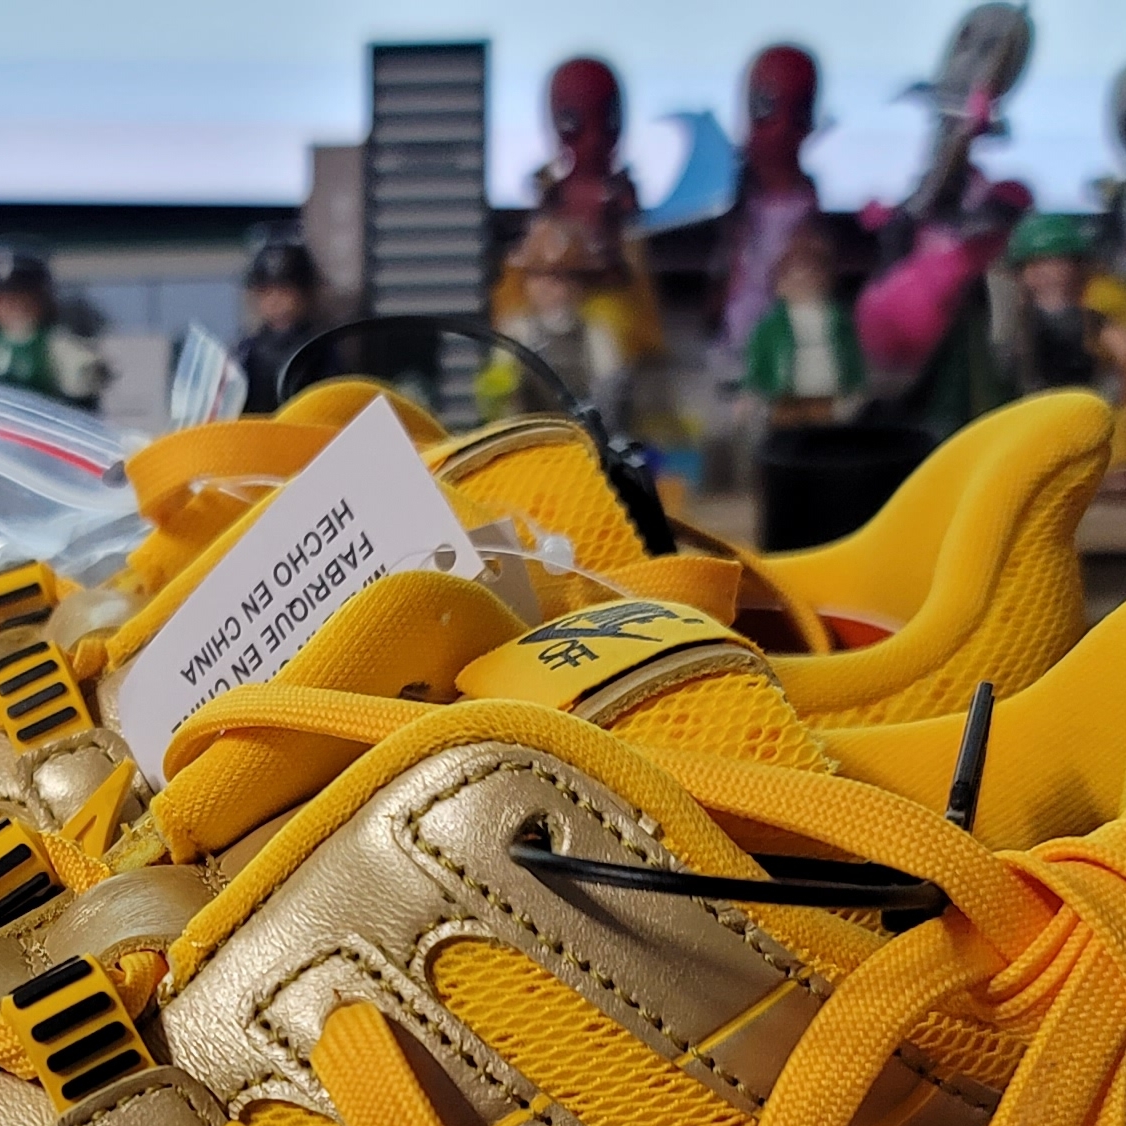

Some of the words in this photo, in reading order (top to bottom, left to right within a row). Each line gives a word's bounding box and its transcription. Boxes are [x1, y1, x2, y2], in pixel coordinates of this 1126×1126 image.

[273, 497, 356, 588] HECHO
[240, 580, 274, 624] EN
[259, 530, 375, 654] FABRIQUE
[179, 616, 242, 687] CHINA
[230, 642, 264, 686] EN
